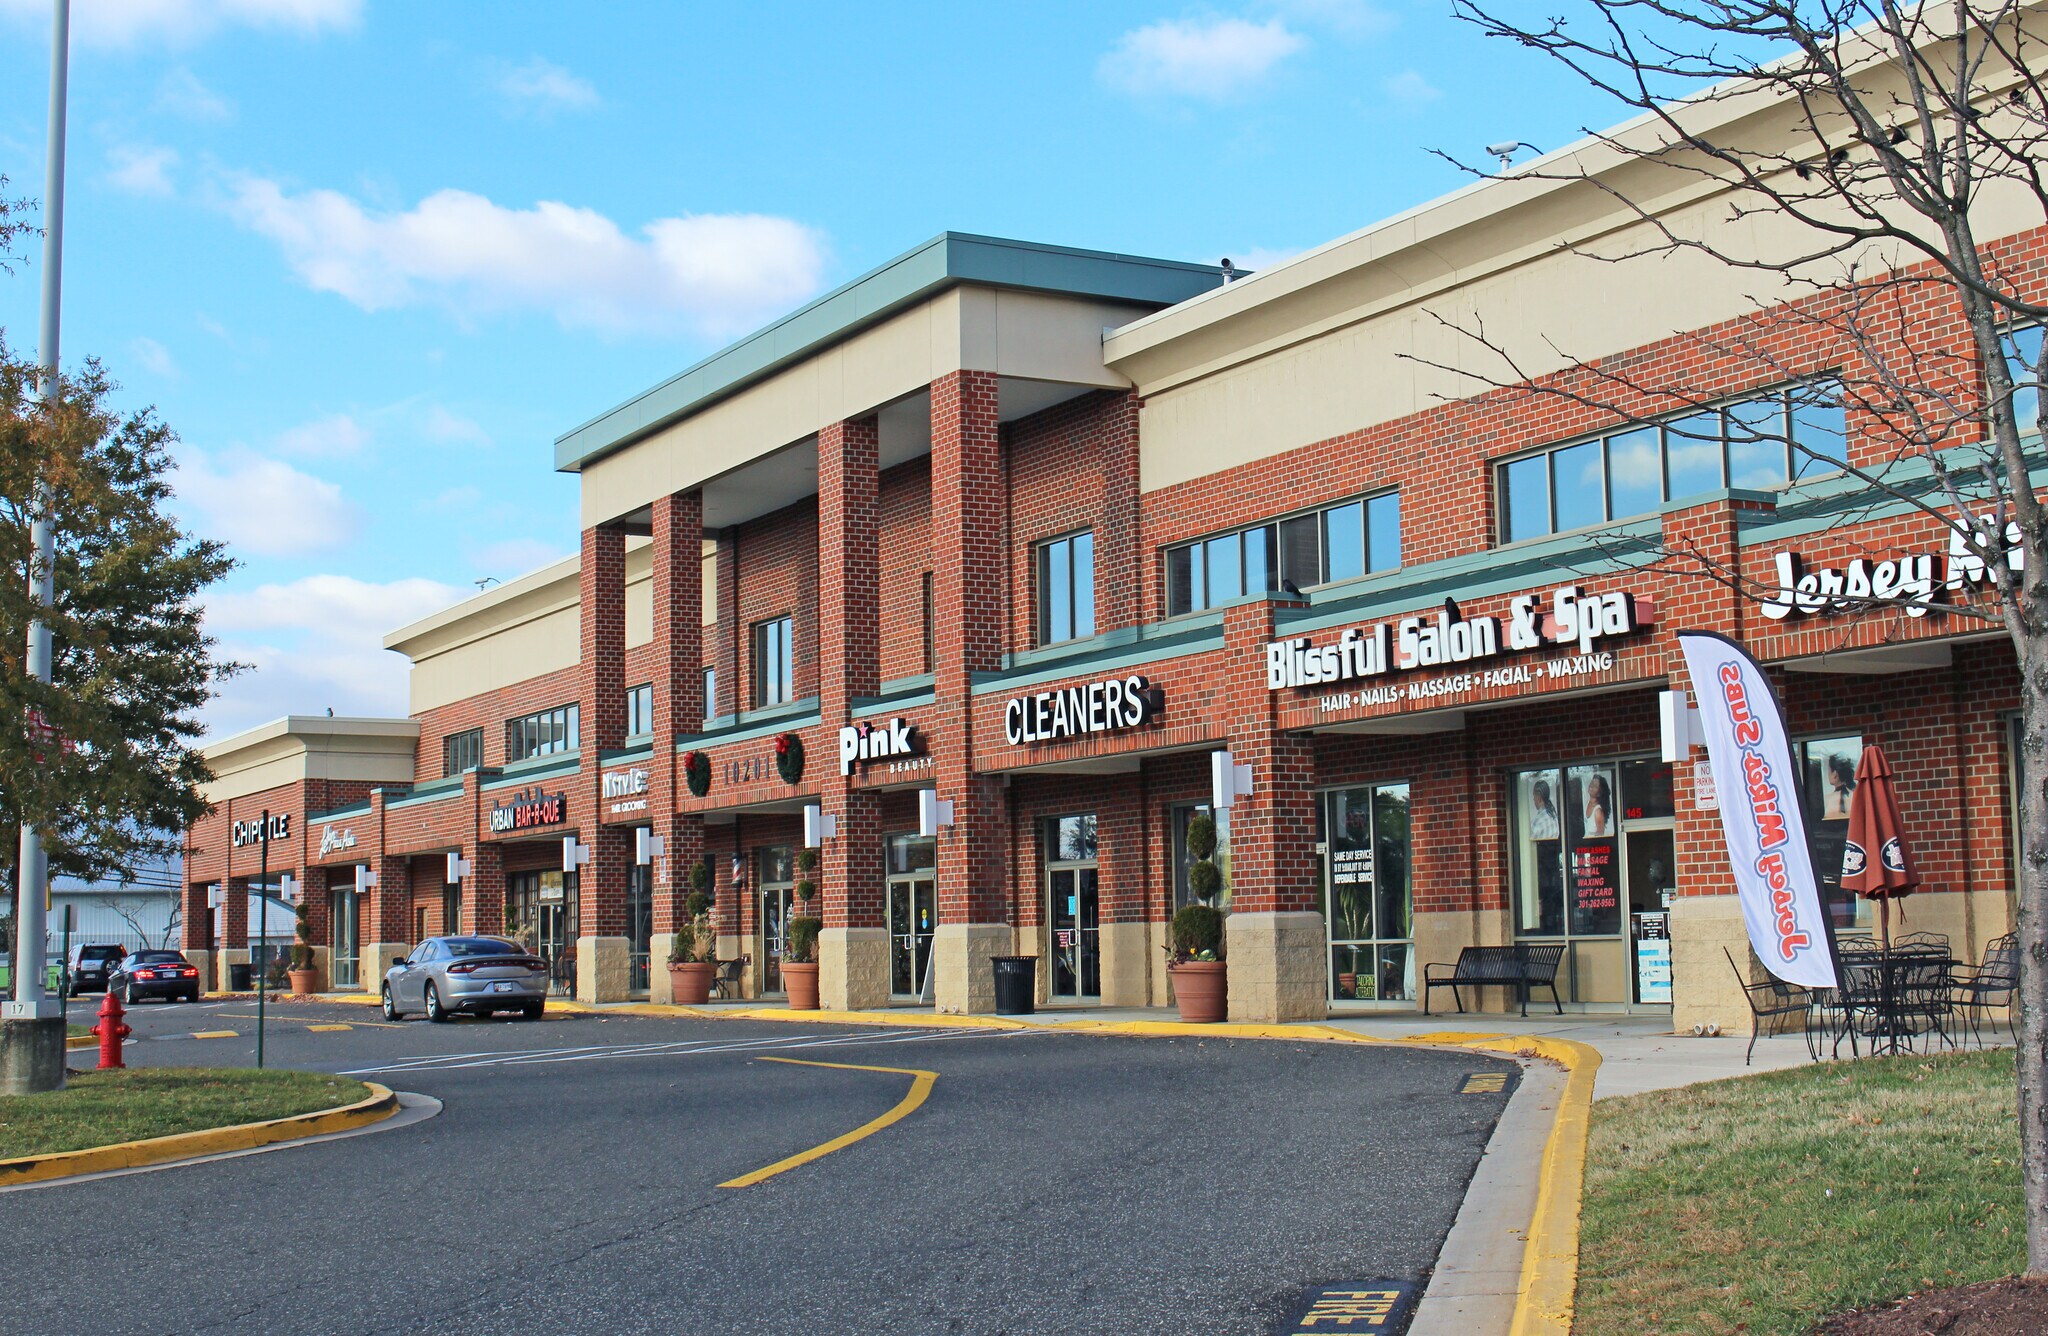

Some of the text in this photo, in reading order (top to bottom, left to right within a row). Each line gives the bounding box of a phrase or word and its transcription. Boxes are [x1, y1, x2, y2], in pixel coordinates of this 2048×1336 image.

[1760, 551, 1934, 620] Jersey
[1267, 585, 1631, 690] Blissful Salon & Spa
[1321, 652, 1613, 713] HAIR NAILS MASSAGE FACIAL WAXING
[1005, 675, 1144, 746] CLEANERS
[724, 755, 770, 785] 10201
[889, 757, 932, 774] BEAUTY
[1700, 766, 1711, 775] NO
[489, 799, 560, 832] URBAN BAR-B-QUE
[1626, 807, 1642, 818] 145
[1334, 849, 1372, 861] SAME DAY SERVICE
[1576, 846, 1611, 855] EYELASHES
[1577, 855, 1609, 865] MASSAGE
[1578, 867, 1600, 876] FACIAL
[1578, 878, 1604, 887] WAXING
[1578, 887, 1613, 898] GIFT CARD
[12, 1004, 24, 1014] 17
[1300, 1291, 1400, 1325] FIRE
